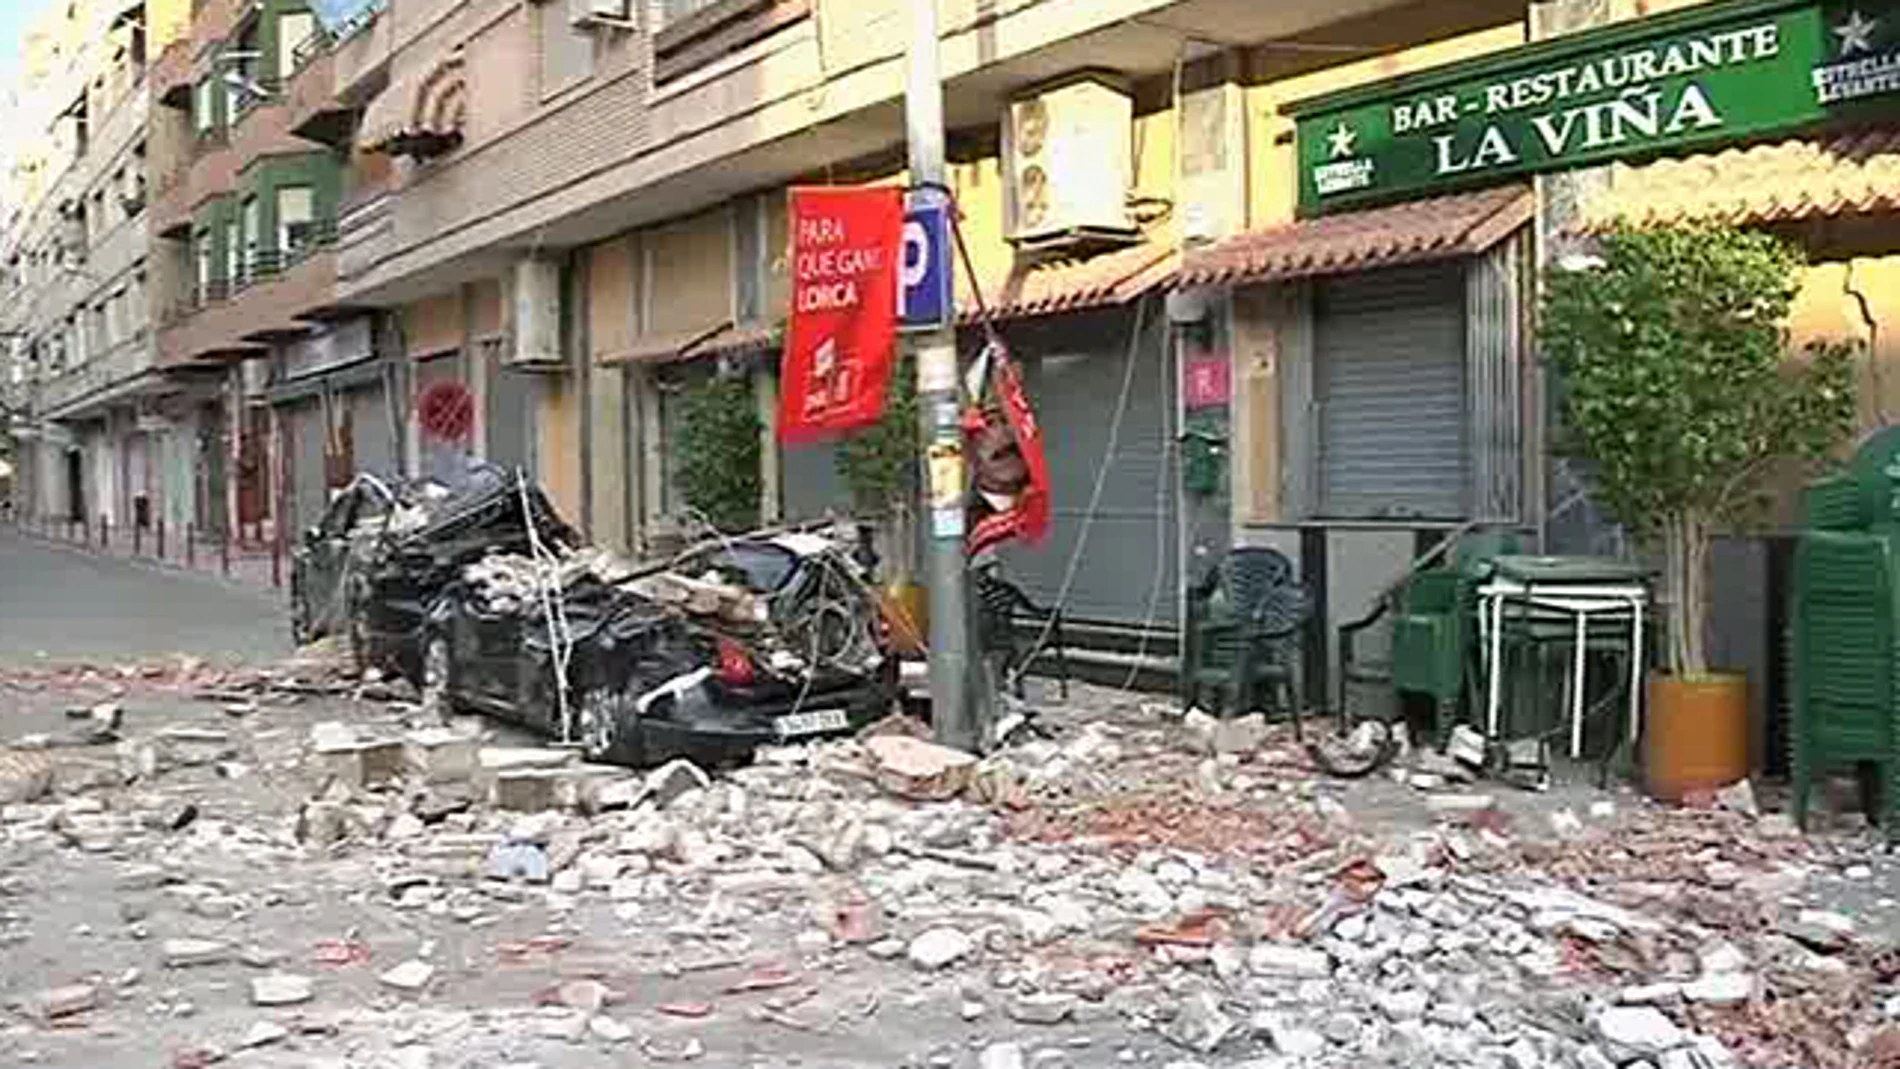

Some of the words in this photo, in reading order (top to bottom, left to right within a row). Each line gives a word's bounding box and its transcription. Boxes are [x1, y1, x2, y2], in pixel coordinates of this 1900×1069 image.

[1393, 95, 1458, 132] BAR
[1486, 24, 1780, 114] RESTAURANTE
[1432, 124, 1518, 174] LA
[1530, 83, 1723, 156] VIÑA
[800, 217, 845, 247] PARA
[798, 251, 836, 280] QUE
[896, 220, 929, 318] P
[798, 281, 859, 313] LORCA
